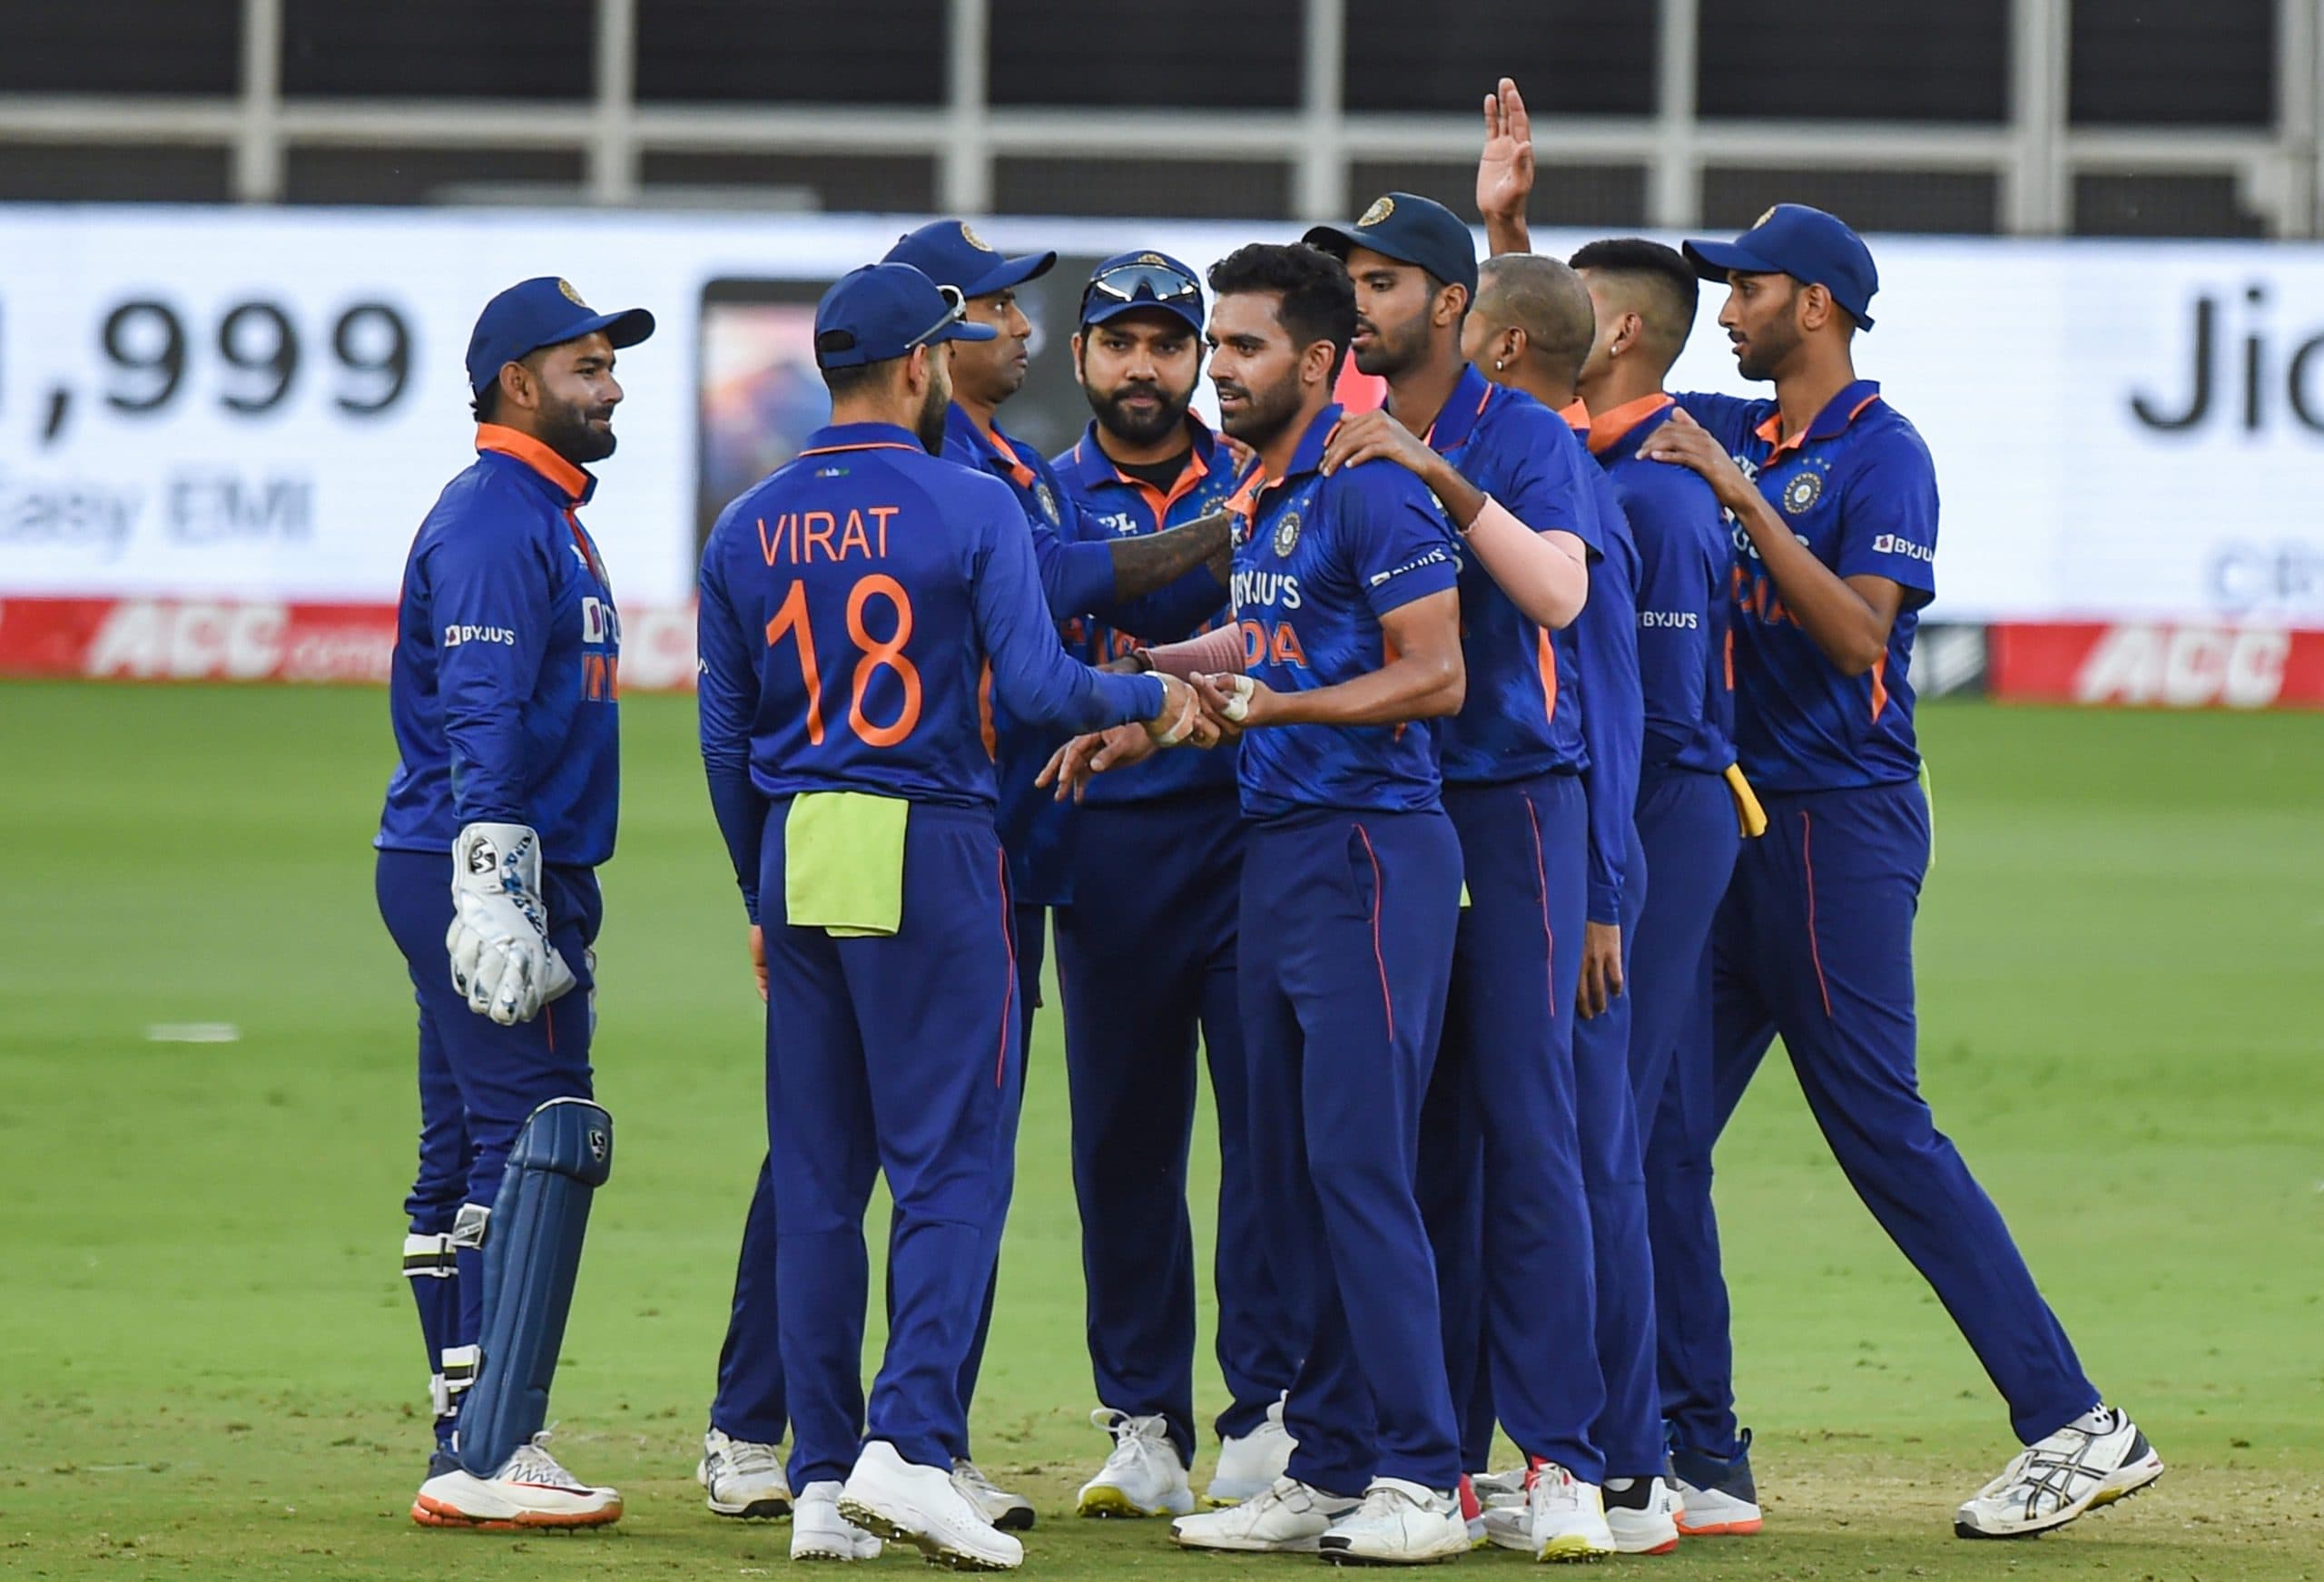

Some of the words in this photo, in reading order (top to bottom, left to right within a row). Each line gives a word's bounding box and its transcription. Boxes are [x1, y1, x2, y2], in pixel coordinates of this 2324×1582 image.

[0, 298, 415, 447] ,999
[757, 506, 900, 567] VIRAT
[1237, 570, 1302, 610] BYJU'S
[1642, 610, 1698, 630] BYJU'S
[91, 597, 290, 679] ACC
[462, 624, 516, 646] BYJU'S
[765, 573, 922, 748] 18
[2079, 623, 2292, 708] ACC
